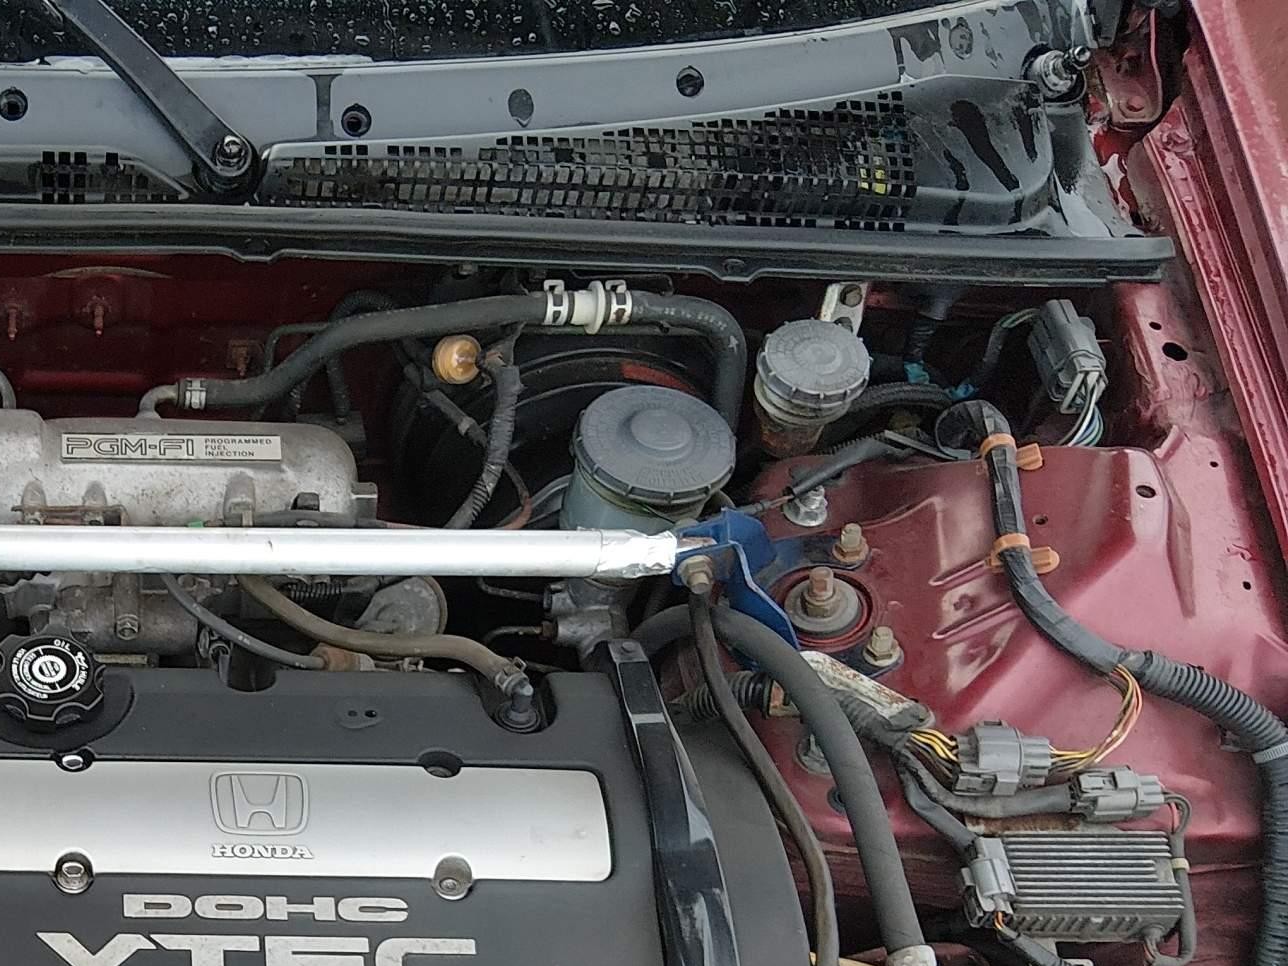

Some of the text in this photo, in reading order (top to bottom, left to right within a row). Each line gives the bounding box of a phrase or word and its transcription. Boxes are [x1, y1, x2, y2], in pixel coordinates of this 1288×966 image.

[66, 437, 194, 457] PGM-FI
[54, 639, 70, 651] OIL
[211, 844, 315, 860] HONDA
[122, 894, 410, 922] DOHC
